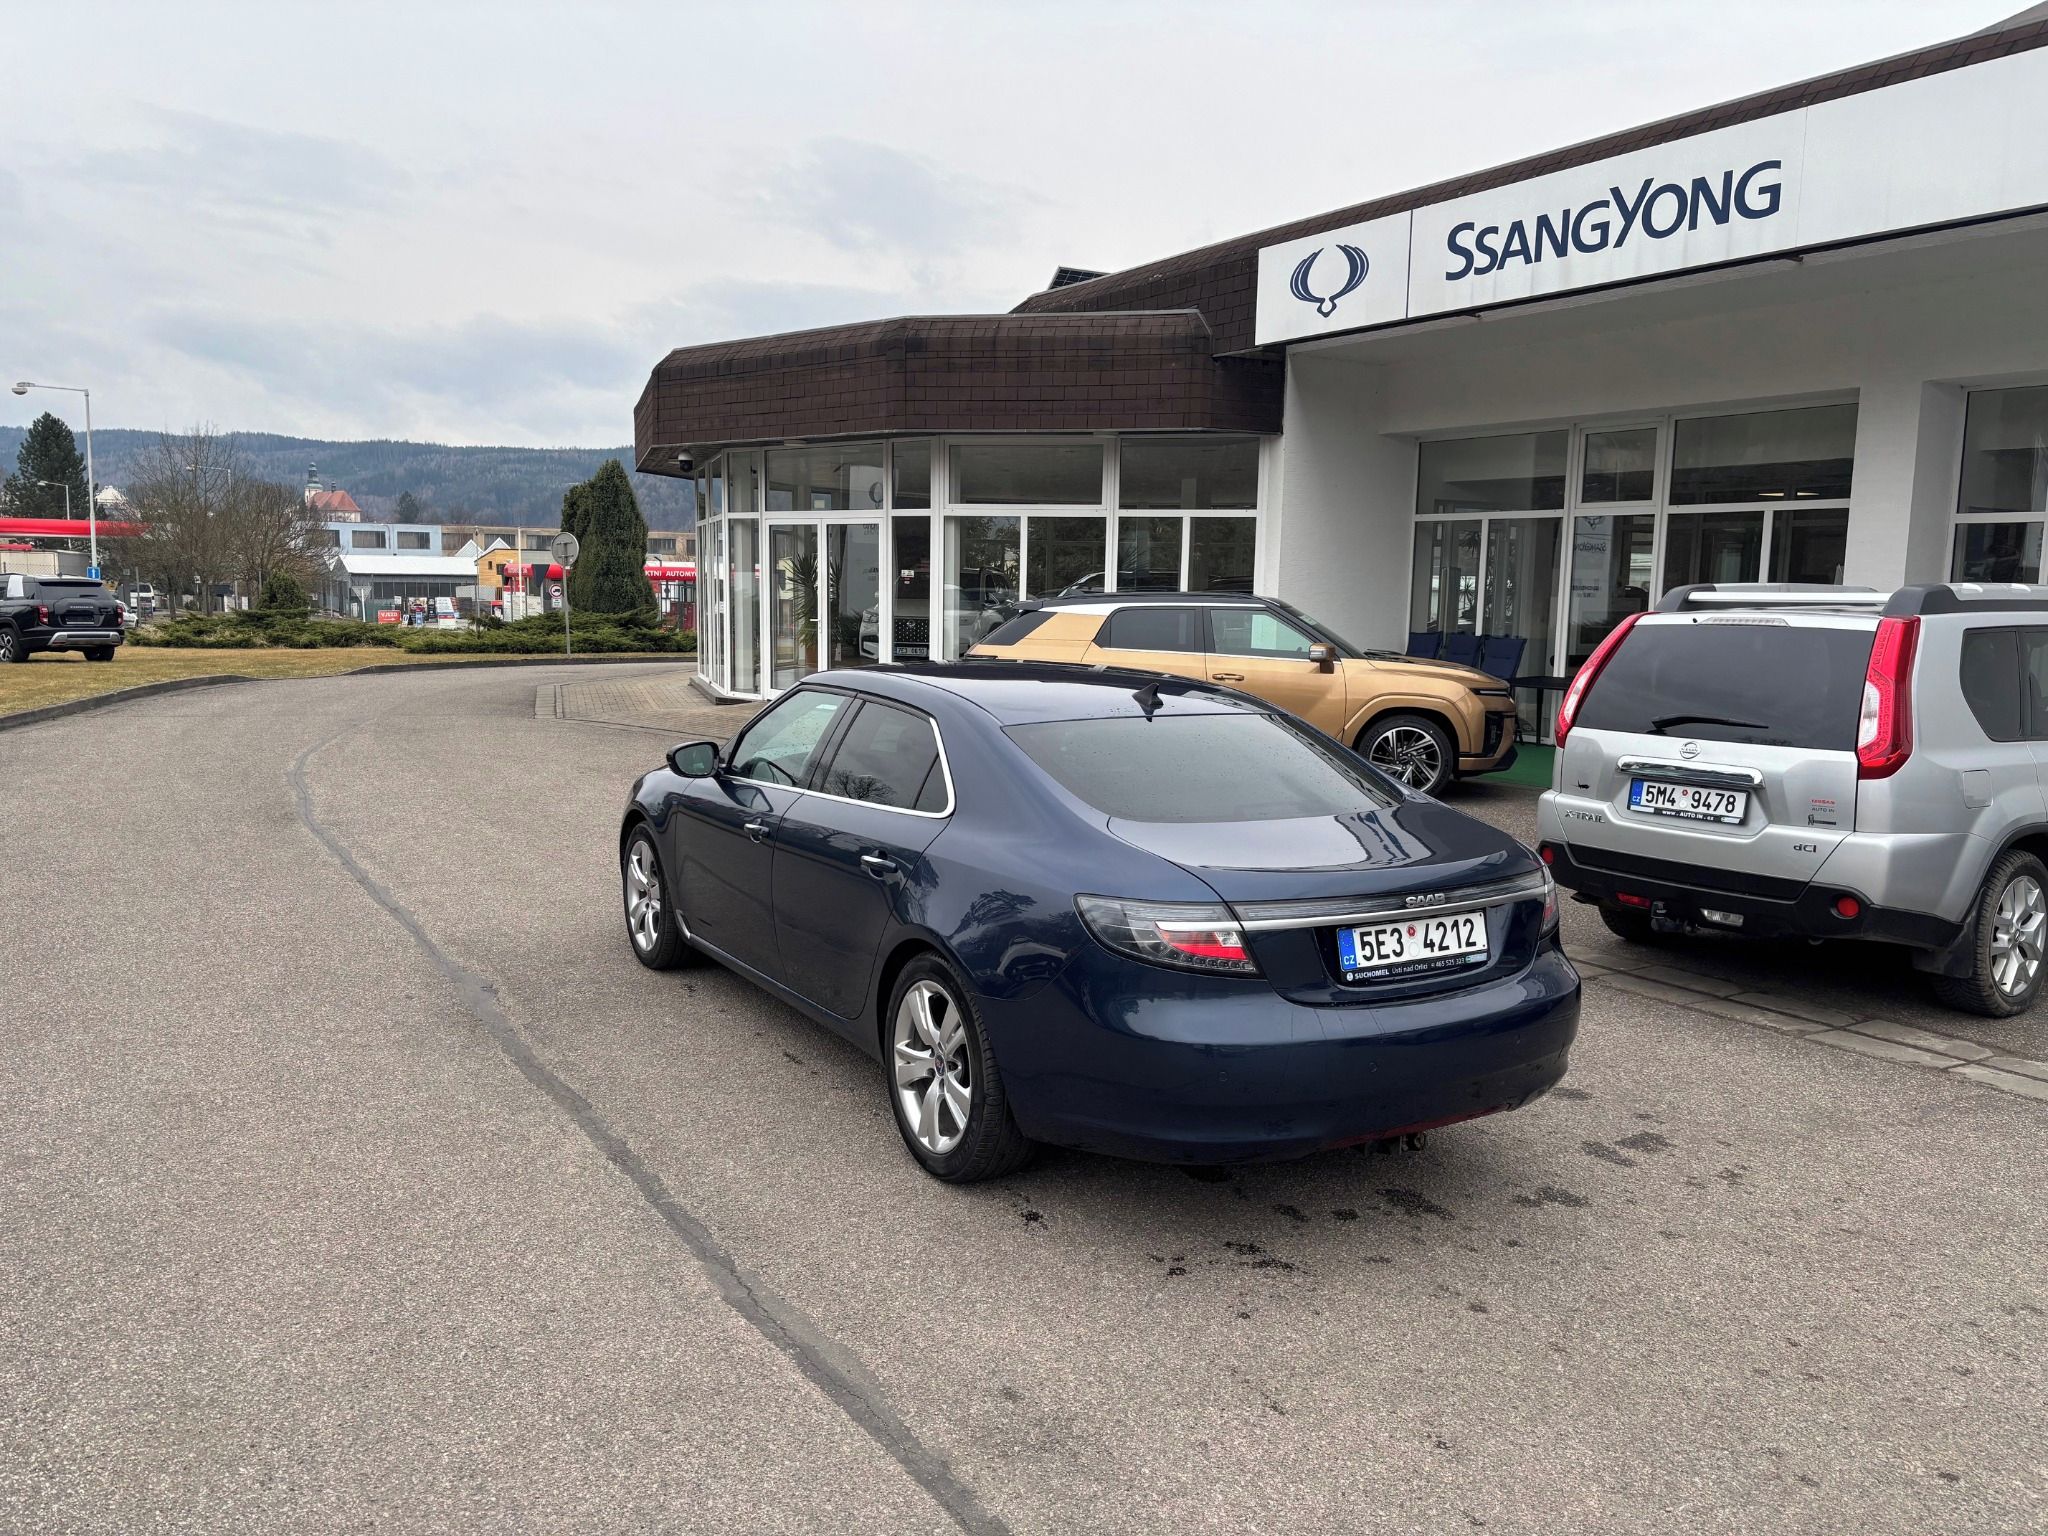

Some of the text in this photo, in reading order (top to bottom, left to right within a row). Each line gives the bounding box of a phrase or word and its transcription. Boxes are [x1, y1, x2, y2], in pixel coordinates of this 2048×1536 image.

[1445, 160, 1783, 282] SSANGYONG
[1646, 785, 1736, 814] 5M4 9478
[1565, 810, 1605, 824] X-TRAIL
[1406, 893, 1445, 908] SAAB
[1360, 918, 1476, 961] 5E3 4212
[1344, 956, 1355, 965] CZ
[1355, 969, 1389, 980] SUCHOMEL
